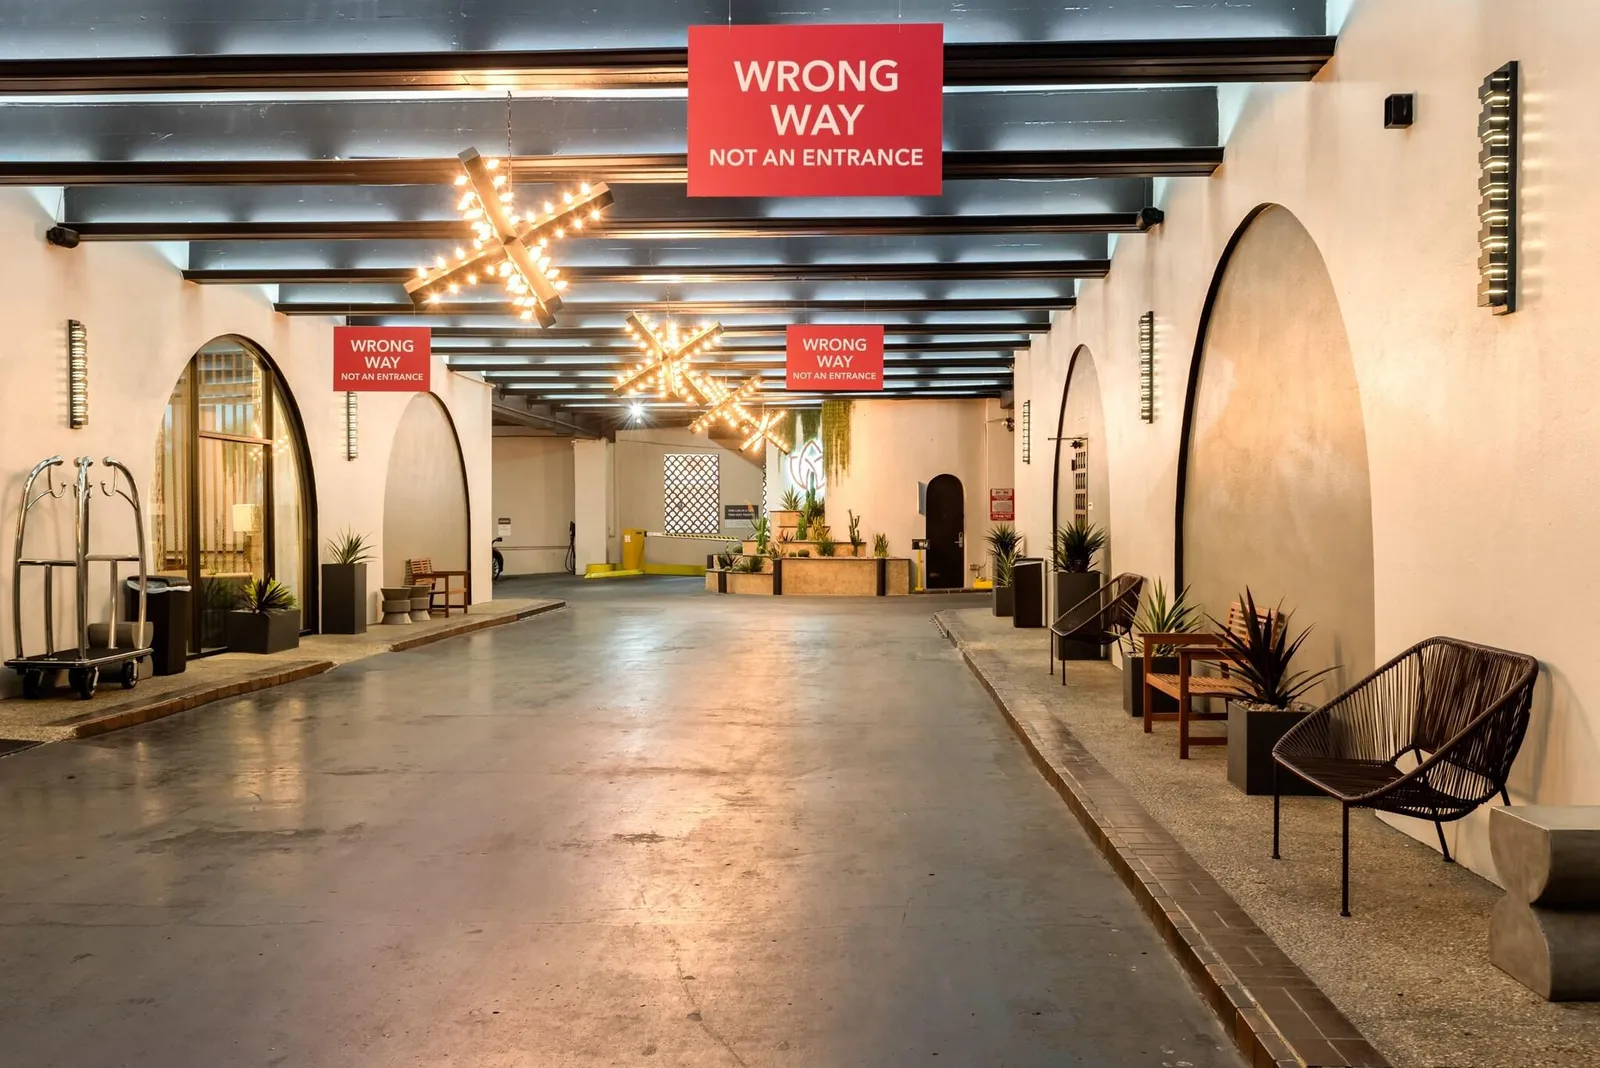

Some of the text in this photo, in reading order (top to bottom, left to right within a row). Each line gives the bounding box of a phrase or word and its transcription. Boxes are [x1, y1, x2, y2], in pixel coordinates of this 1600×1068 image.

[733, 59, 899, 93] WRONG
[769, 103, 865, 136] WAY
[709, 148, 924, 167] NOT AN ENTRANCE
[350, 339, 415, 353] WRONG
[802, 337, 867, 351] WRONG
[364, 355, 401, 369] WAY
[816, 354, 854, 368] WAY
[341, 372, 424, 381] NOT AN ENTRANCE
[792, 371, 877, 381] NOT AN ENTRANCE
